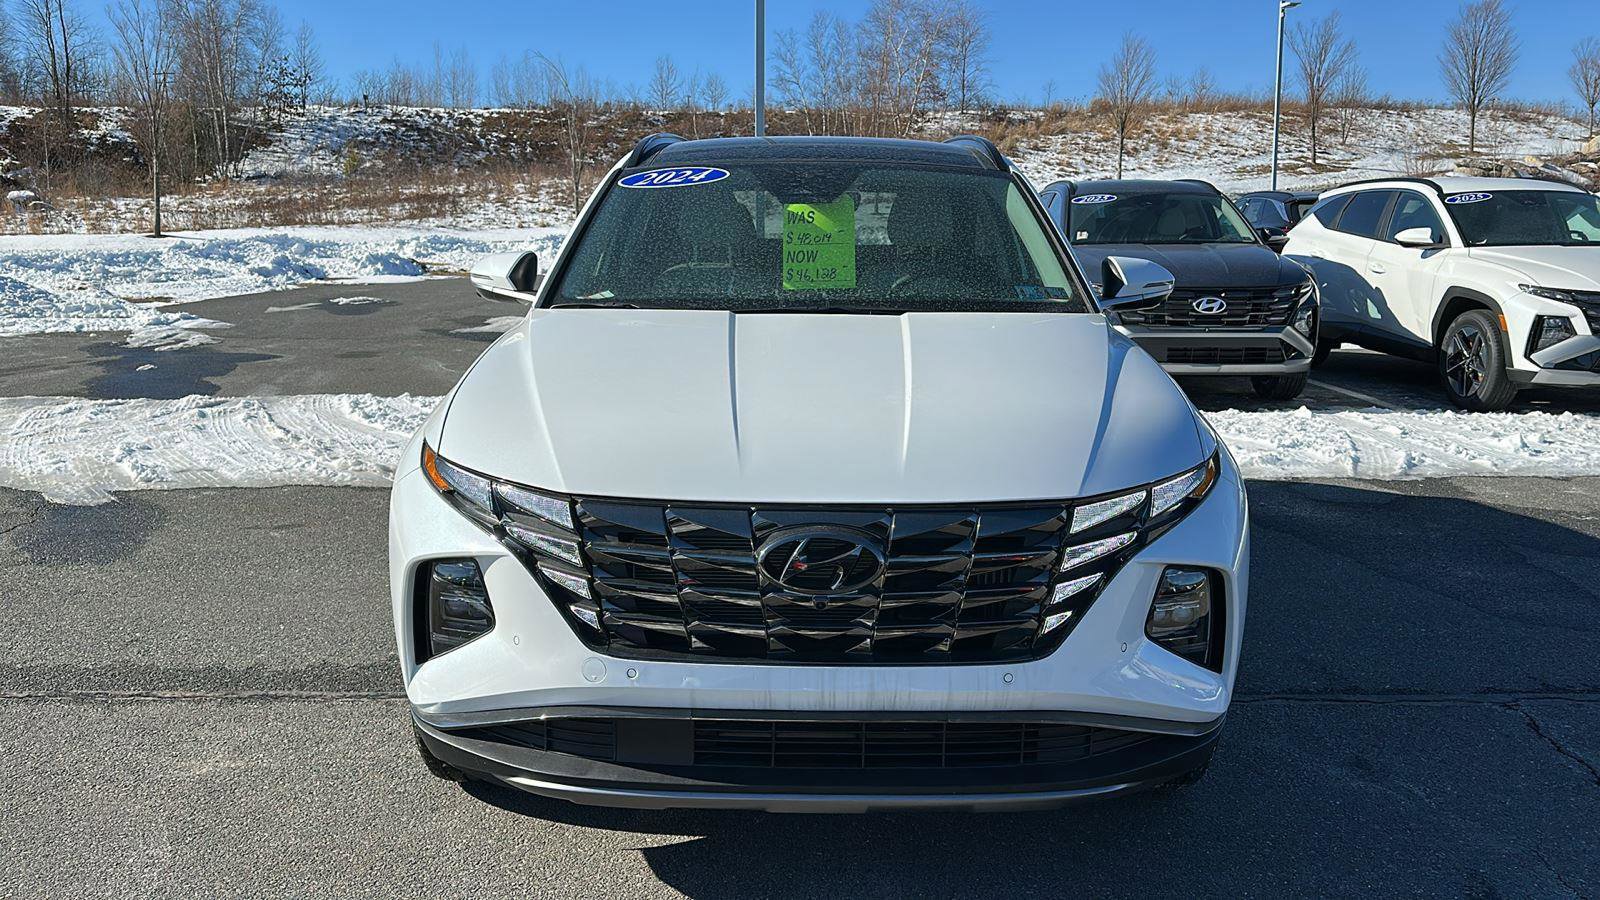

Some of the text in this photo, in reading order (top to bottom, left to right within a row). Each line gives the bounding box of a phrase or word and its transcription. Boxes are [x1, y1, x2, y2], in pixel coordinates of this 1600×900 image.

[633, 169, 711, 186] 2024
[1456, 193, 1484, 203] 2025
[787, 210, 815, 225] WAS
[786, 250, 819, 264] NOW
